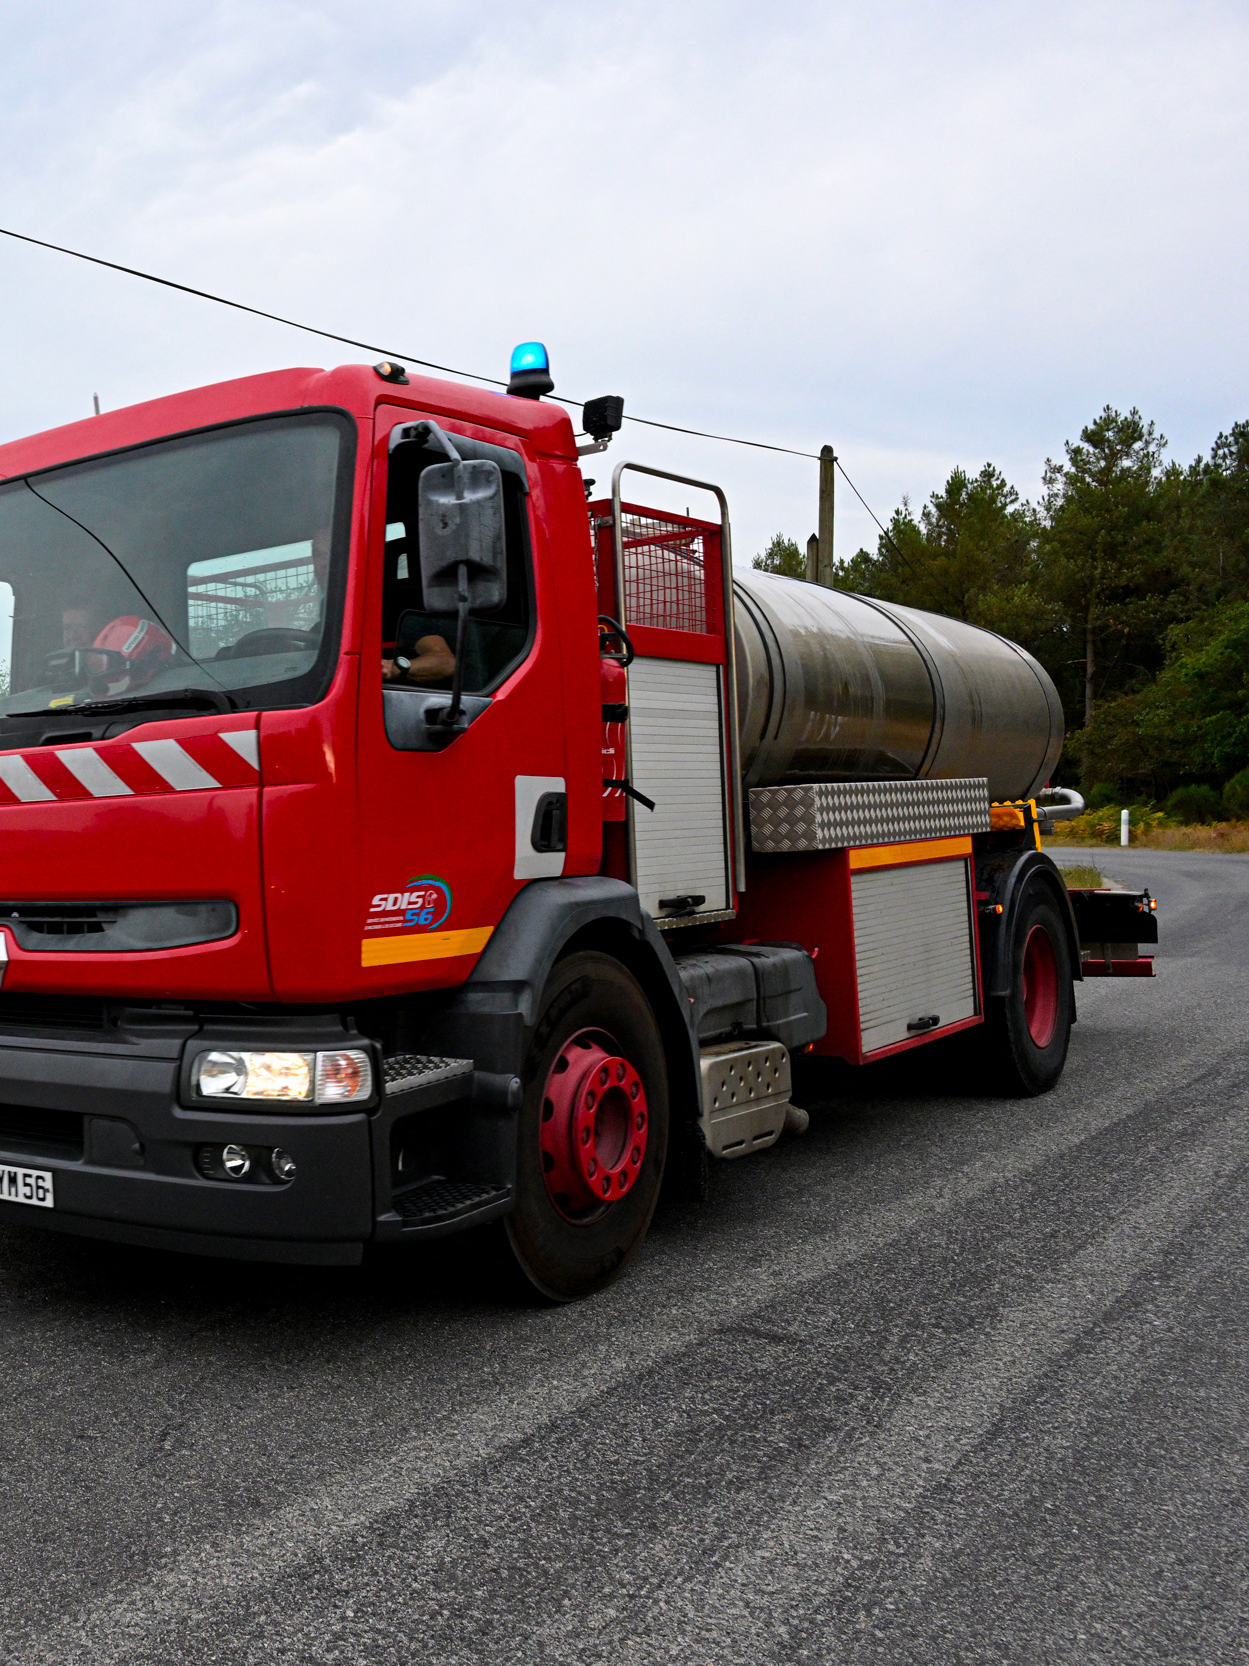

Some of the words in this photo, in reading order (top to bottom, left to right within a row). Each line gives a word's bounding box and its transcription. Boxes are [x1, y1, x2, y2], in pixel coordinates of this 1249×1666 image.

[369, 891, 425, 912] SDIS
[403, 908, 435, 926] 56
[23, 1173, 46, 1202] 56
